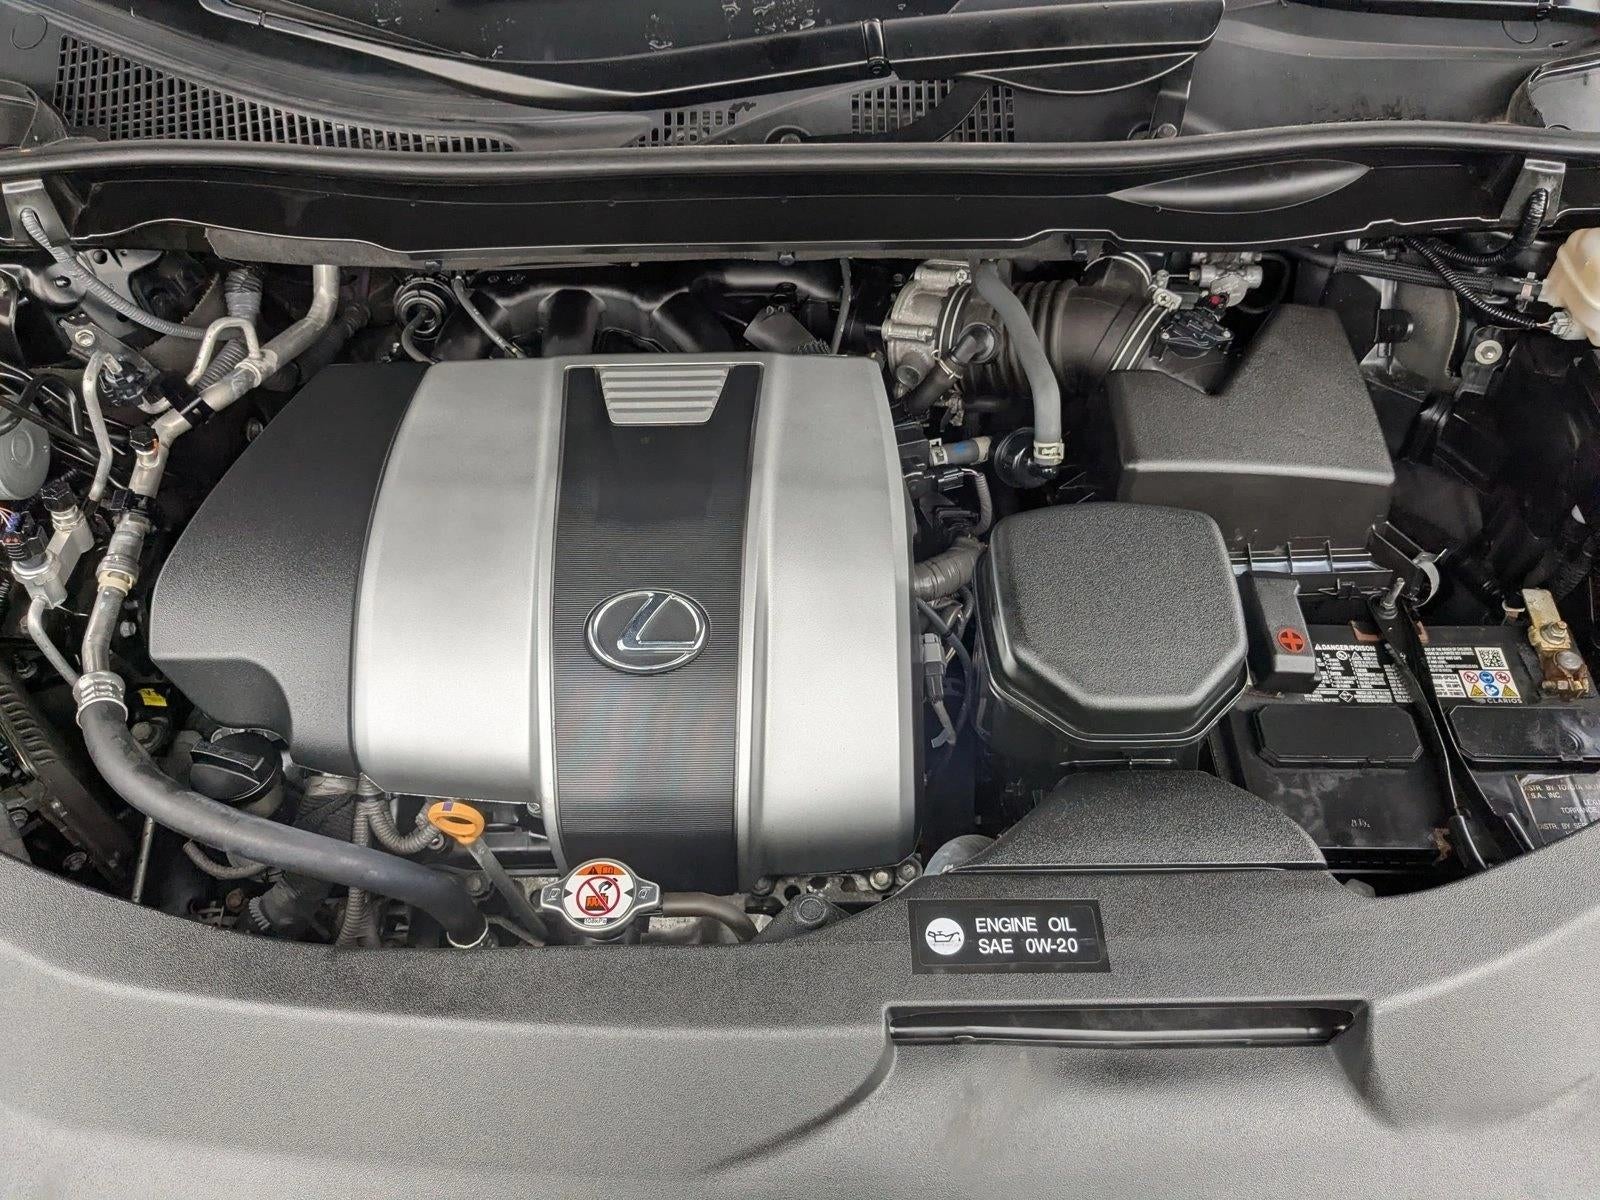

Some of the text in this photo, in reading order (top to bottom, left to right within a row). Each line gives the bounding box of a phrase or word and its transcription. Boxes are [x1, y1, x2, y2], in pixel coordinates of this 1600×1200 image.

[1321, 644, 1376, 652] DANGER/POISON
[975, 917, 1077, 933] ENGINE OIL
[978, 937, 1079, 954] SAE 0W-20
